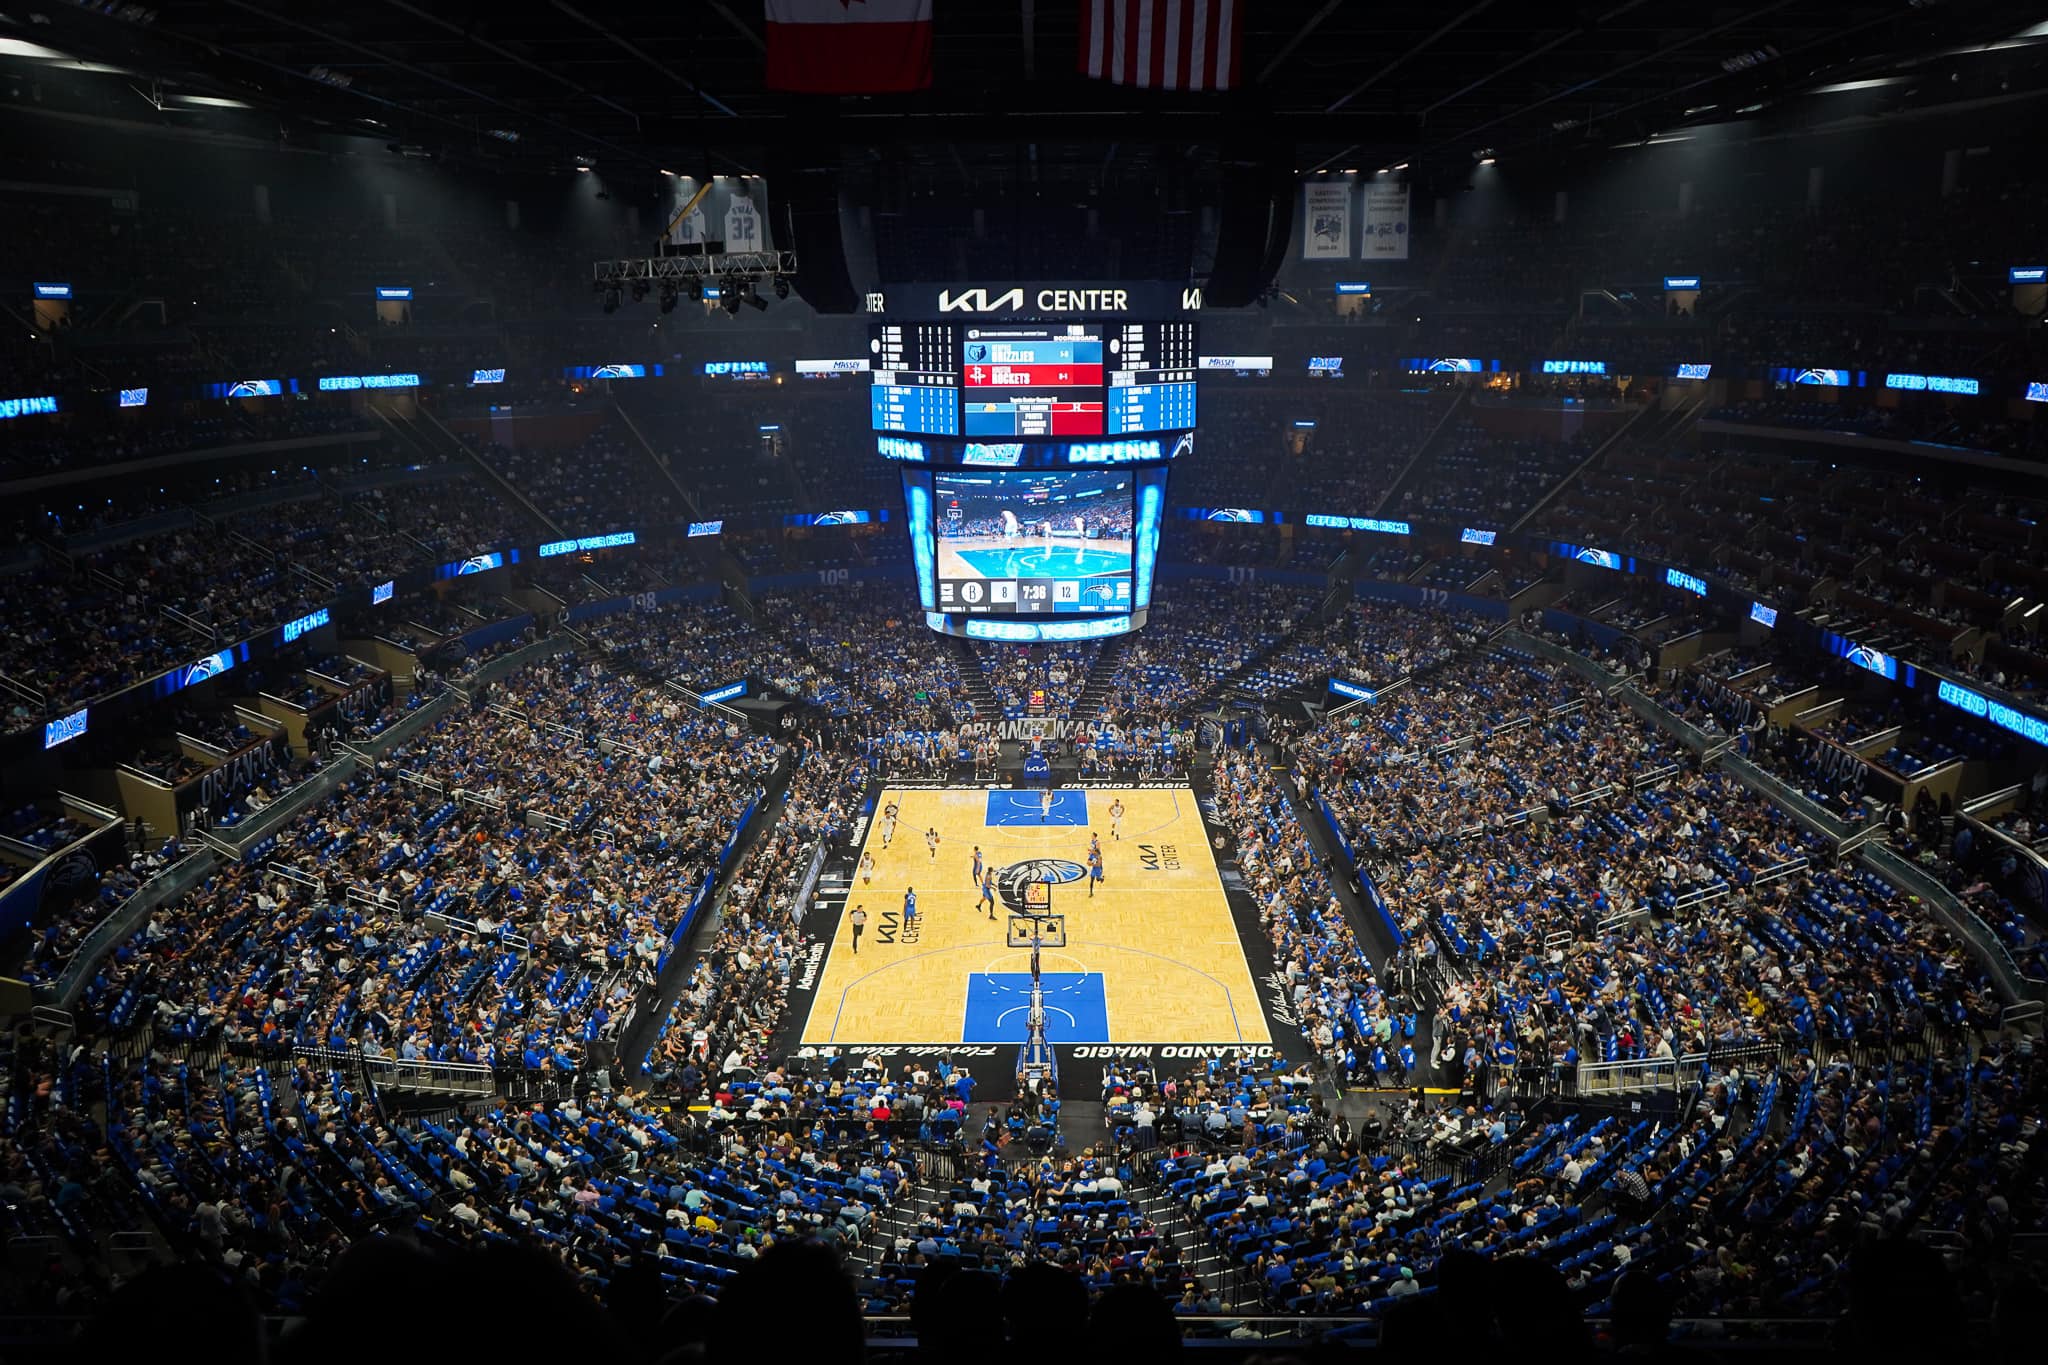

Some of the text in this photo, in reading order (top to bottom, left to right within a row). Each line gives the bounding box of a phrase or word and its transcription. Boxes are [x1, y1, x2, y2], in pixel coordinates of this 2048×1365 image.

[732, 216, 755, 240] 32
[1037, 289, 1127, 312] CENTER
[705, 361, 768, 374] DEFENSE
[320, 374, 419, 390] DEFEND YOUR HOME
[1886, 374, 1927, 390] DEFEND
[1069, 440, 1161, 461] DEFENSE
[1306, 514, 1409, 535] DEFEND YOUR HOME
[539, 532, 635, 557] DEFEND YOUR HOME
[818, 568, 848, 585] 109
[1667, 568, 1707, 596] DEFENSE
[1421, 587, 1449, 606] 112
[284, 607, 330, 643] DEFENSE
[1938, 680, 1988, 717] DEFEND
[1988, 700, 2024, 735] YOUR
[1160, 844, 1181, 871] CENTER
[796, 942, 825, 990] AdventHealth
[850, 1045, 998, 1057] Florida Blue
[1073, 1046, 1152, 1059] MAGIC
